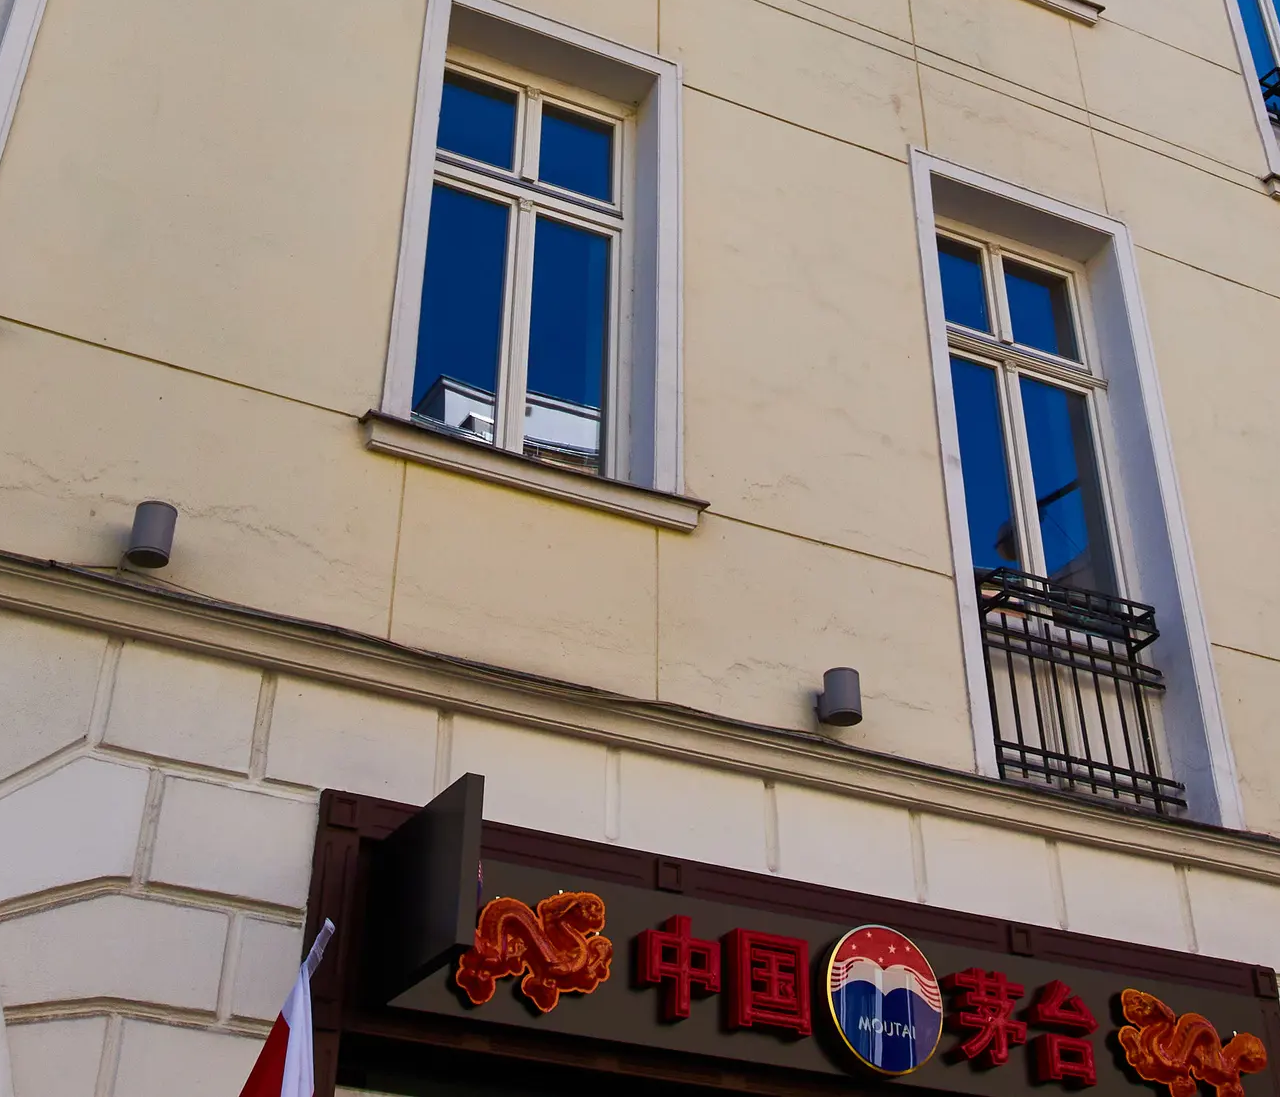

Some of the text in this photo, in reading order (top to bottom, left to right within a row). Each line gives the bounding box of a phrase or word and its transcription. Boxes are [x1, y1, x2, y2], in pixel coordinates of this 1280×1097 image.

[639, 914, 1099, 1086] 中国 茅台
[858, 1015, 916, 1040] MOUTAI
